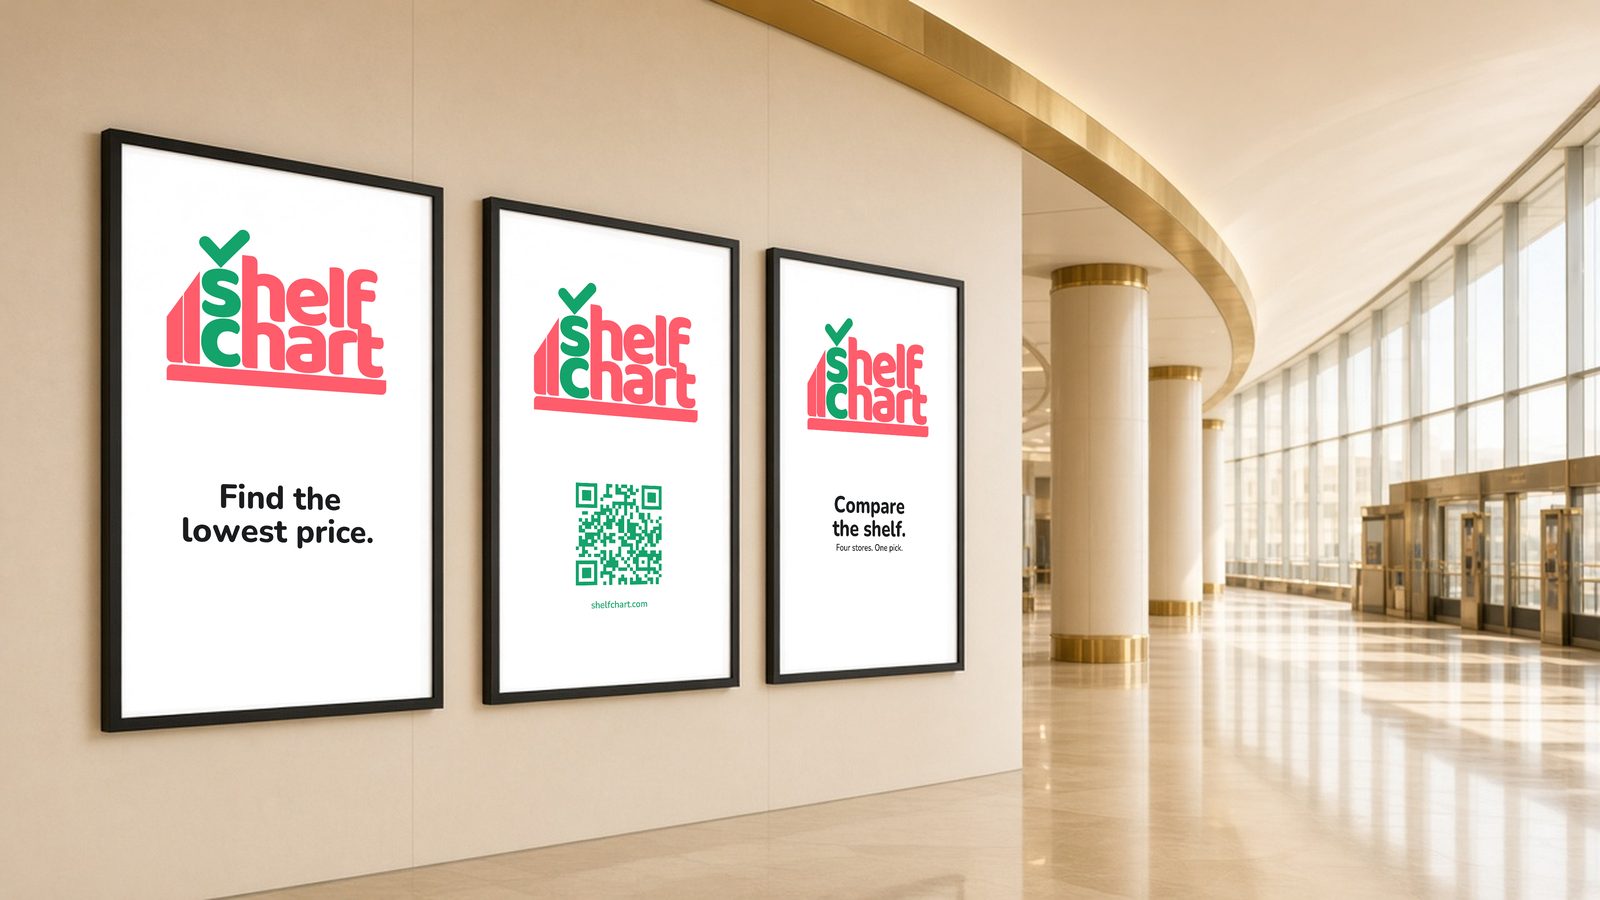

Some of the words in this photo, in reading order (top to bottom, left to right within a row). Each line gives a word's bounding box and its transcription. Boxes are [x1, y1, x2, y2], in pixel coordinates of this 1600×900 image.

[202, 255, 378, 329] shelf
[201, 318, 384, 378] chart
[560, 304, 692, 368] shelf
[826, 337, 924, 389] shelf
[559, 357, 696, 408] chart
[826, 383, 928, 425] chart
[220, 484, 283, 509] Find
[293, 486, 341, 511] the
[834, 495, 905, 518] Compare
[182, 517, 288, 543] lowest
[297, 519, 374, 549] price.
[832, 519, 859, 537] the
[863, 519, 906, 537] shelf.
[836, 543, 850, 552] Four
[851, 544, 873, 552] stores.
[874, 543, 888, 552] One
[888, 543, 903, 553] pick.
[591, 600, 648, 609] shelfchart.com
